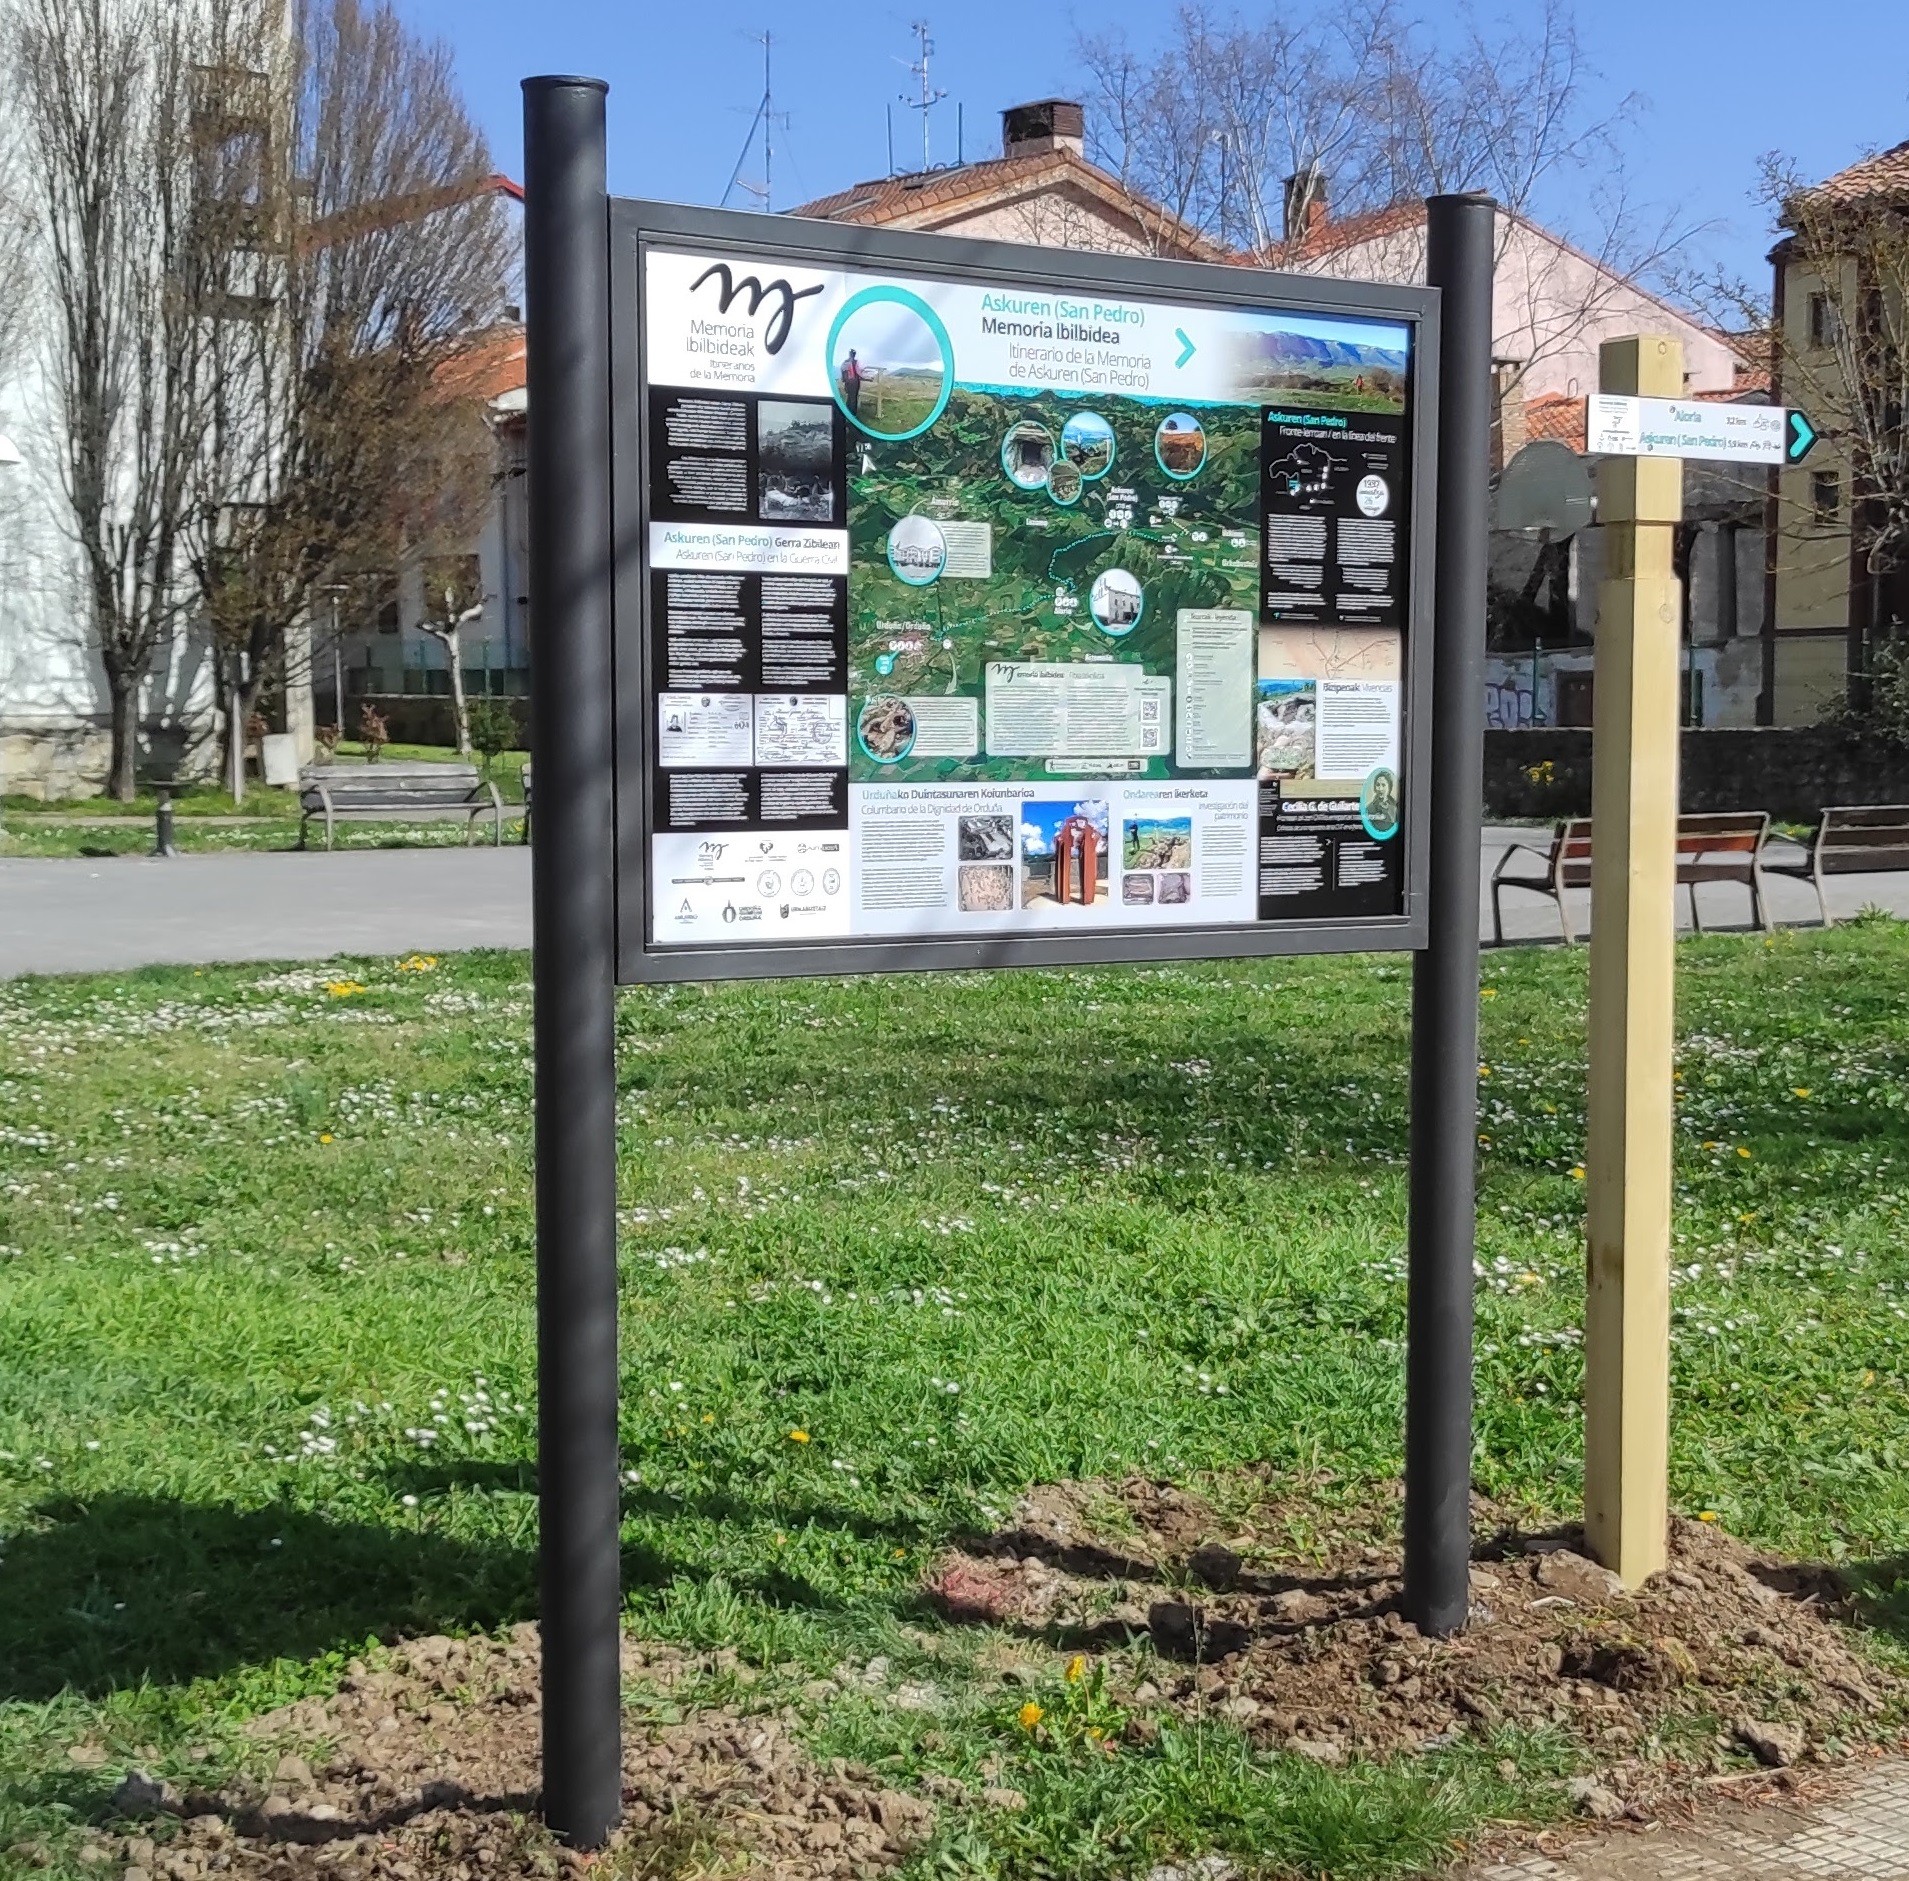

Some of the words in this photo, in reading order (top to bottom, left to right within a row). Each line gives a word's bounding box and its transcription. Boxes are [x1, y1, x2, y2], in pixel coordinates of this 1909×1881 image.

[981, 293, 1051, 316] Askuren
[1054, 301, 1089, 320] (San
[1094, 304, 1145, 328] Pedro)
[690, 319, 755, 339] Memoria
[982, 317, 1053, 339] Memoria
[1056, 323, 1120, 345] Ibilbidea
[686, 336, 755, 357] Ibilbideak
[1009, 342, 1064, 362] Itinerario
[1066, 347, 1082, 364] de
[1085, 348, 1095, 364] la
[1098, 350, 1151, 369] Memoria
[689, 368, 702, 379] de
[703, 369, 712, 380] la
[713, 370, 756, 383] Memoria
[1009, 361, 1026, 378] de
[1028, 363, 1079, 382] Askuren
[1081, 367, 1107, 385] (San
[1109, 369, 1150, 391] Pedro)
[664, 531, 711, 544] Askuren
[712, 533, 735, 547] (San
[738, 534, 773, 549] Pedro)
[775, 537, 802, 548] Gerra
[676, 549, 714, 560] Askuren
[767, 553, 779, 564] en
[780, 551, 788, 564] la
[911, 788, 980, 800] Duintasunaren
[907, 804, 918, 815] de
[919, 804, 927, 815] la
[928, 803, 962, 817] Dignidad
[962, 803, 973, 814] de
